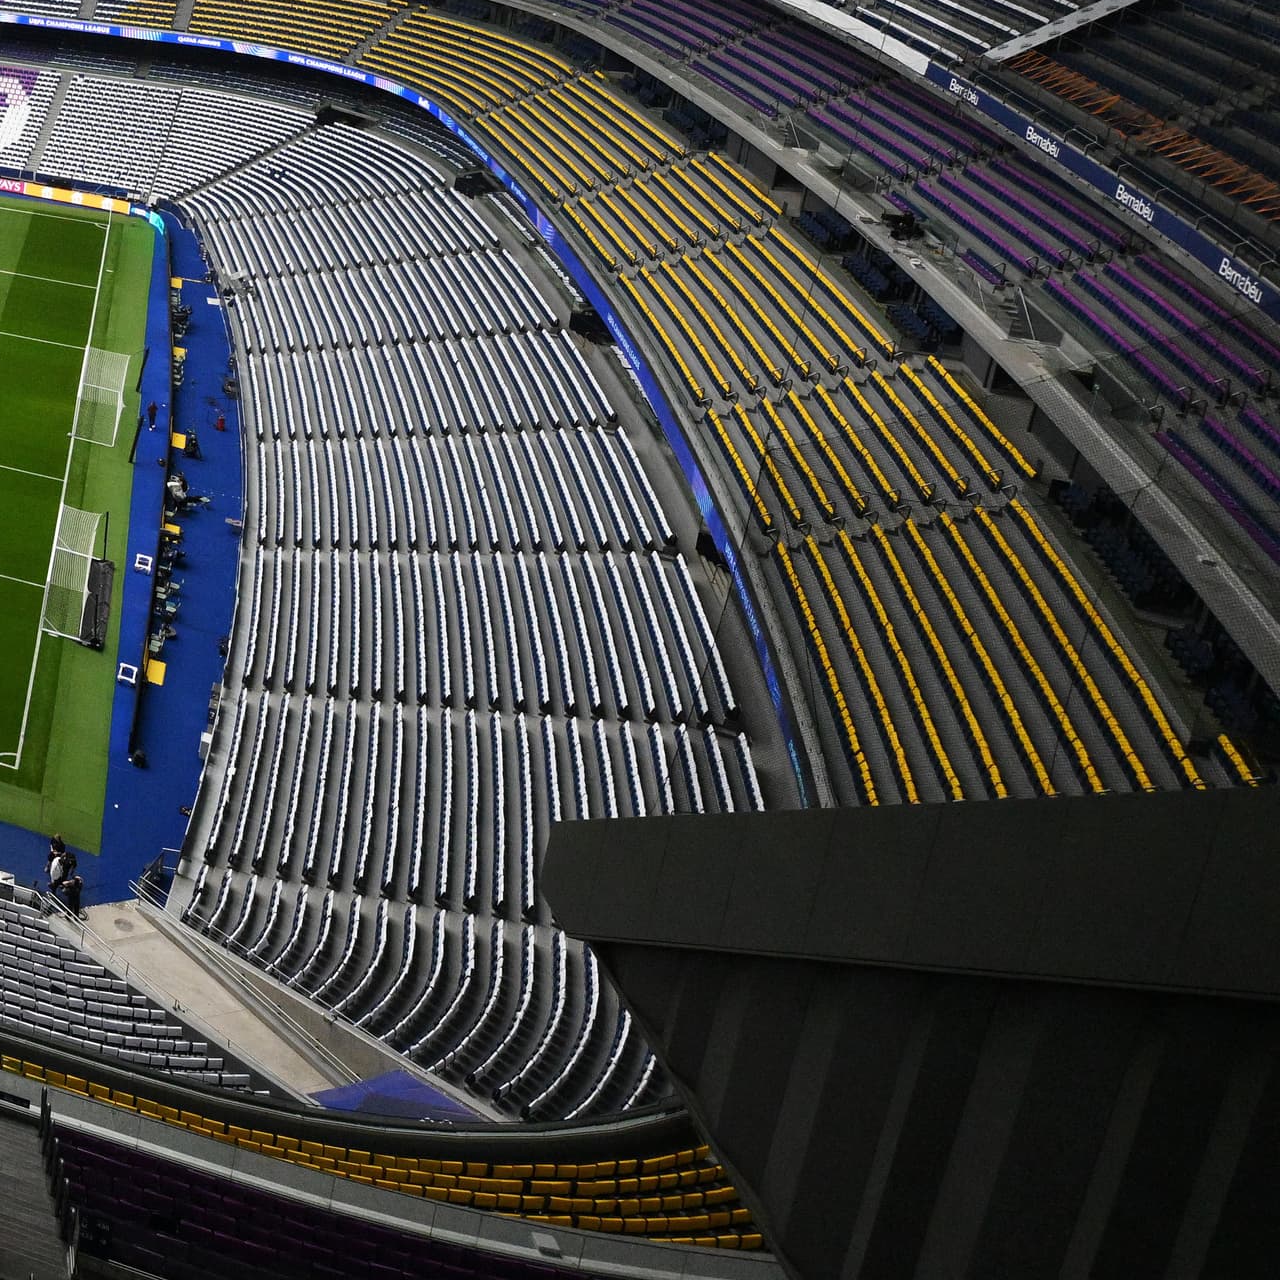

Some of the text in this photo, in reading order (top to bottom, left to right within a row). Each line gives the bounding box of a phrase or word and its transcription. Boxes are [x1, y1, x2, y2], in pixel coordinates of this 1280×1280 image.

[949, 78, 979, 106] Berabéu
[1026, 126, 1060, 158] Bernabéu
[1115, 184, 1154, 222] Bernabéu
[1218, 258, 1264, 304] Bernabéu
